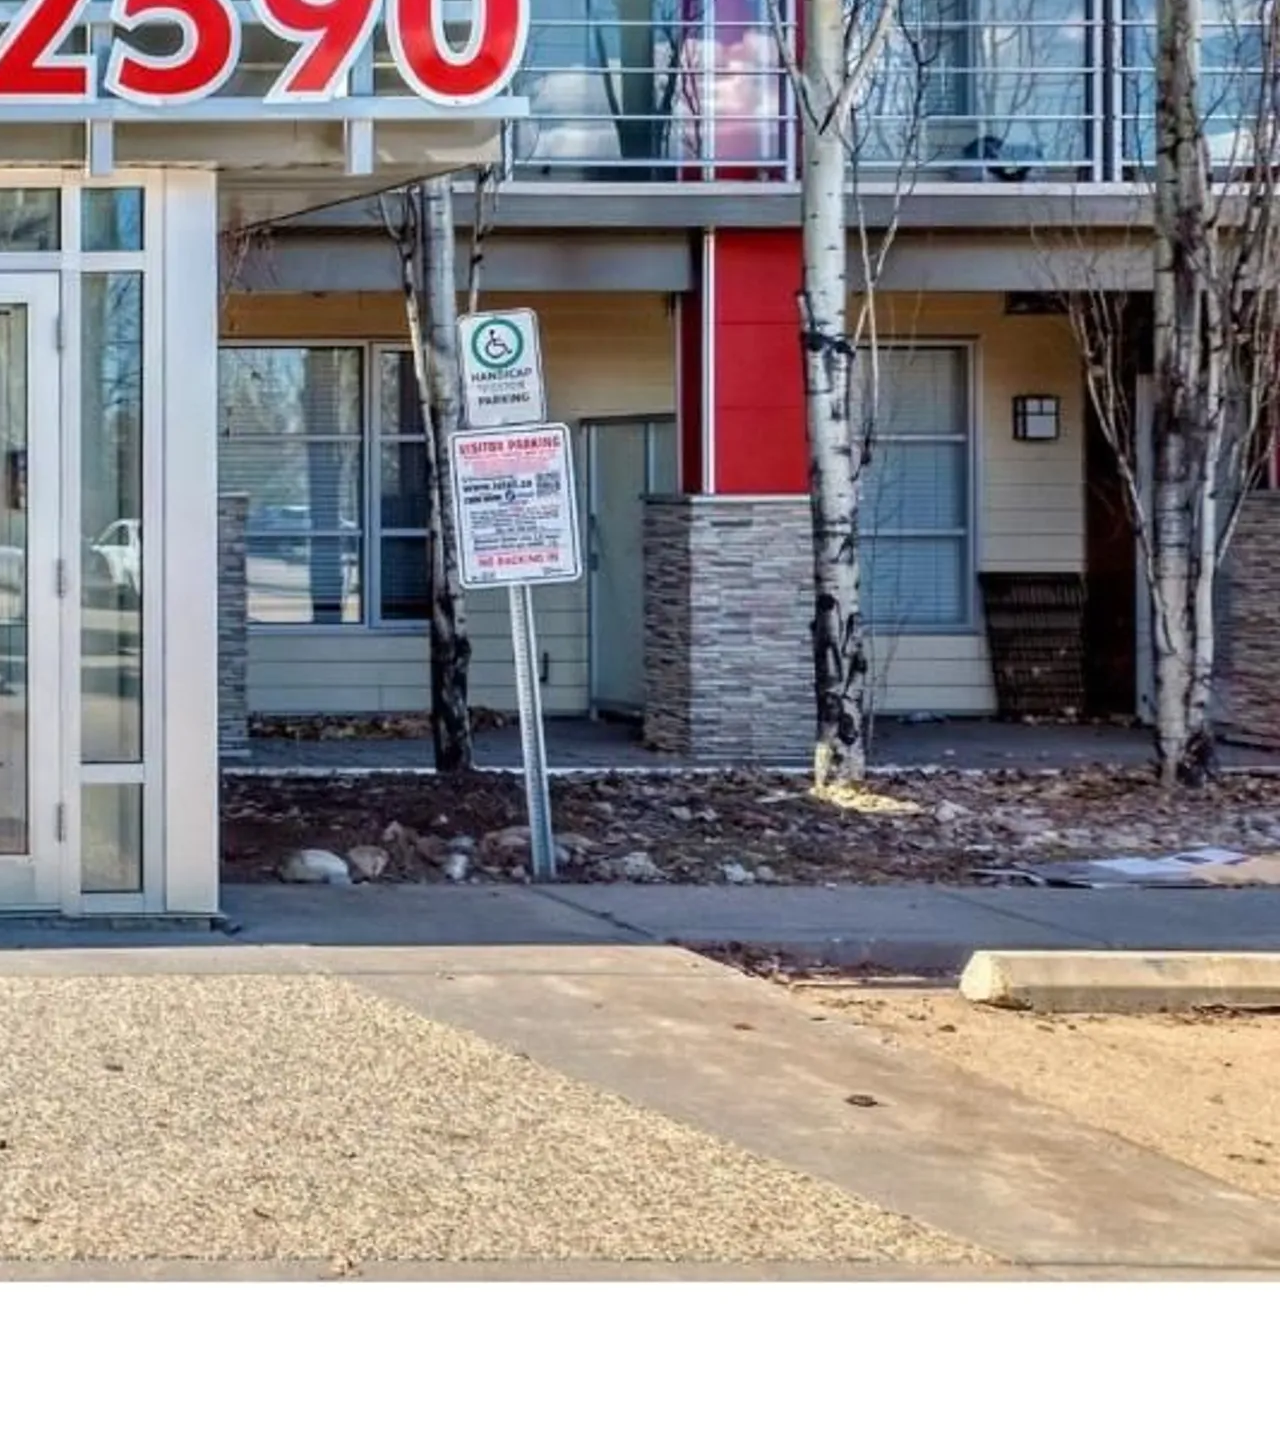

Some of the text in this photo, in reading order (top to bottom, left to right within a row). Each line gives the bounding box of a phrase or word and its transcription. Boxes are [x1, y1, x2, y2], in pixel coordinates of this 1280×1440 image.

[471, 367, 533, 382] HANDICAP
[478, 392, 531, 406] PARKING
[459, 441, 504, 455] VISITOR
[507, 434, 561, 449] PARKING
